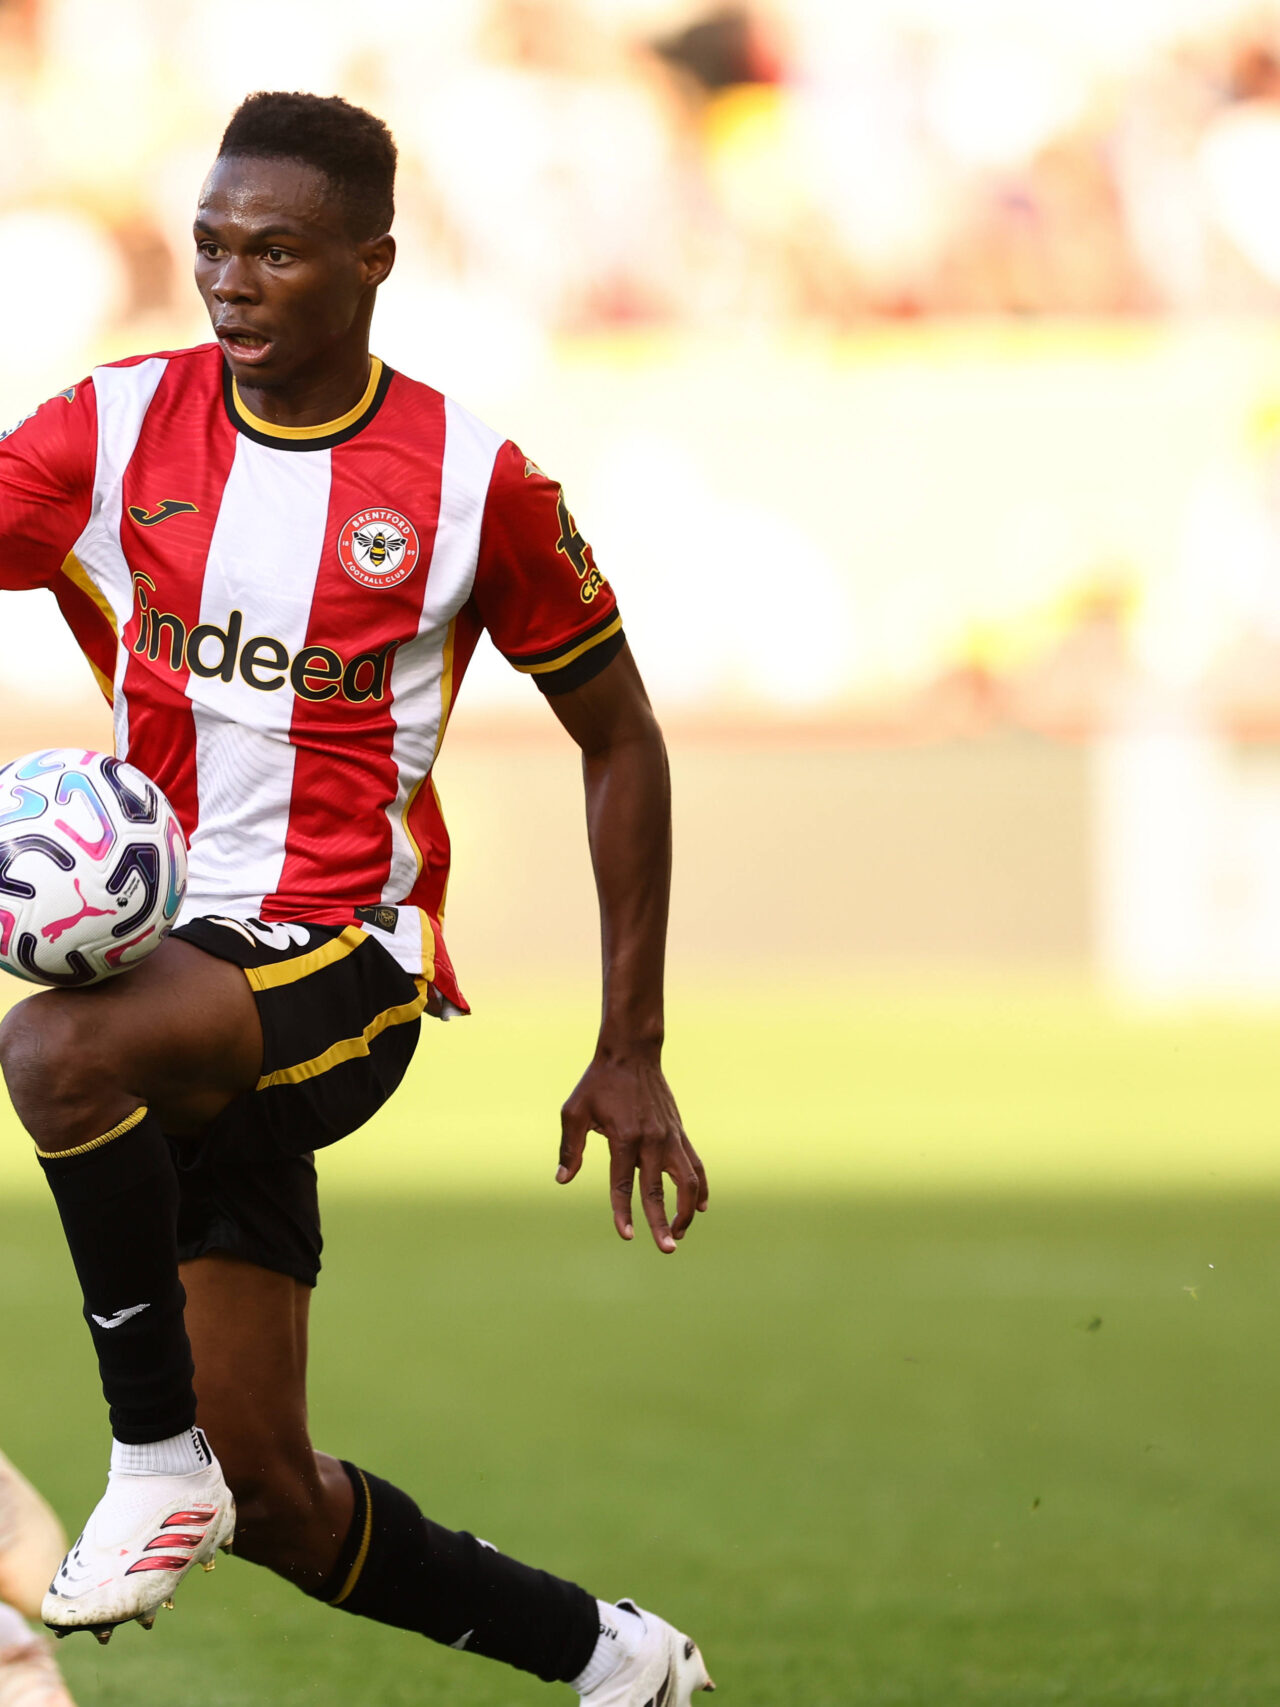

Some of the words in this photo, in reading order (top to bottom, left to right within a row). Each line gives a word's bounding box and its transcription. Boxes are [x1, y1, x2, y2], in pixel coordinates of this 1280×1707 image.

[352, 511, 410, 534] BRENTFORD
[347, 561, 383, 584] FOOTBALL
[385, 569, 405, 583] CLUB
[132, 571, 400, 703] indeed
